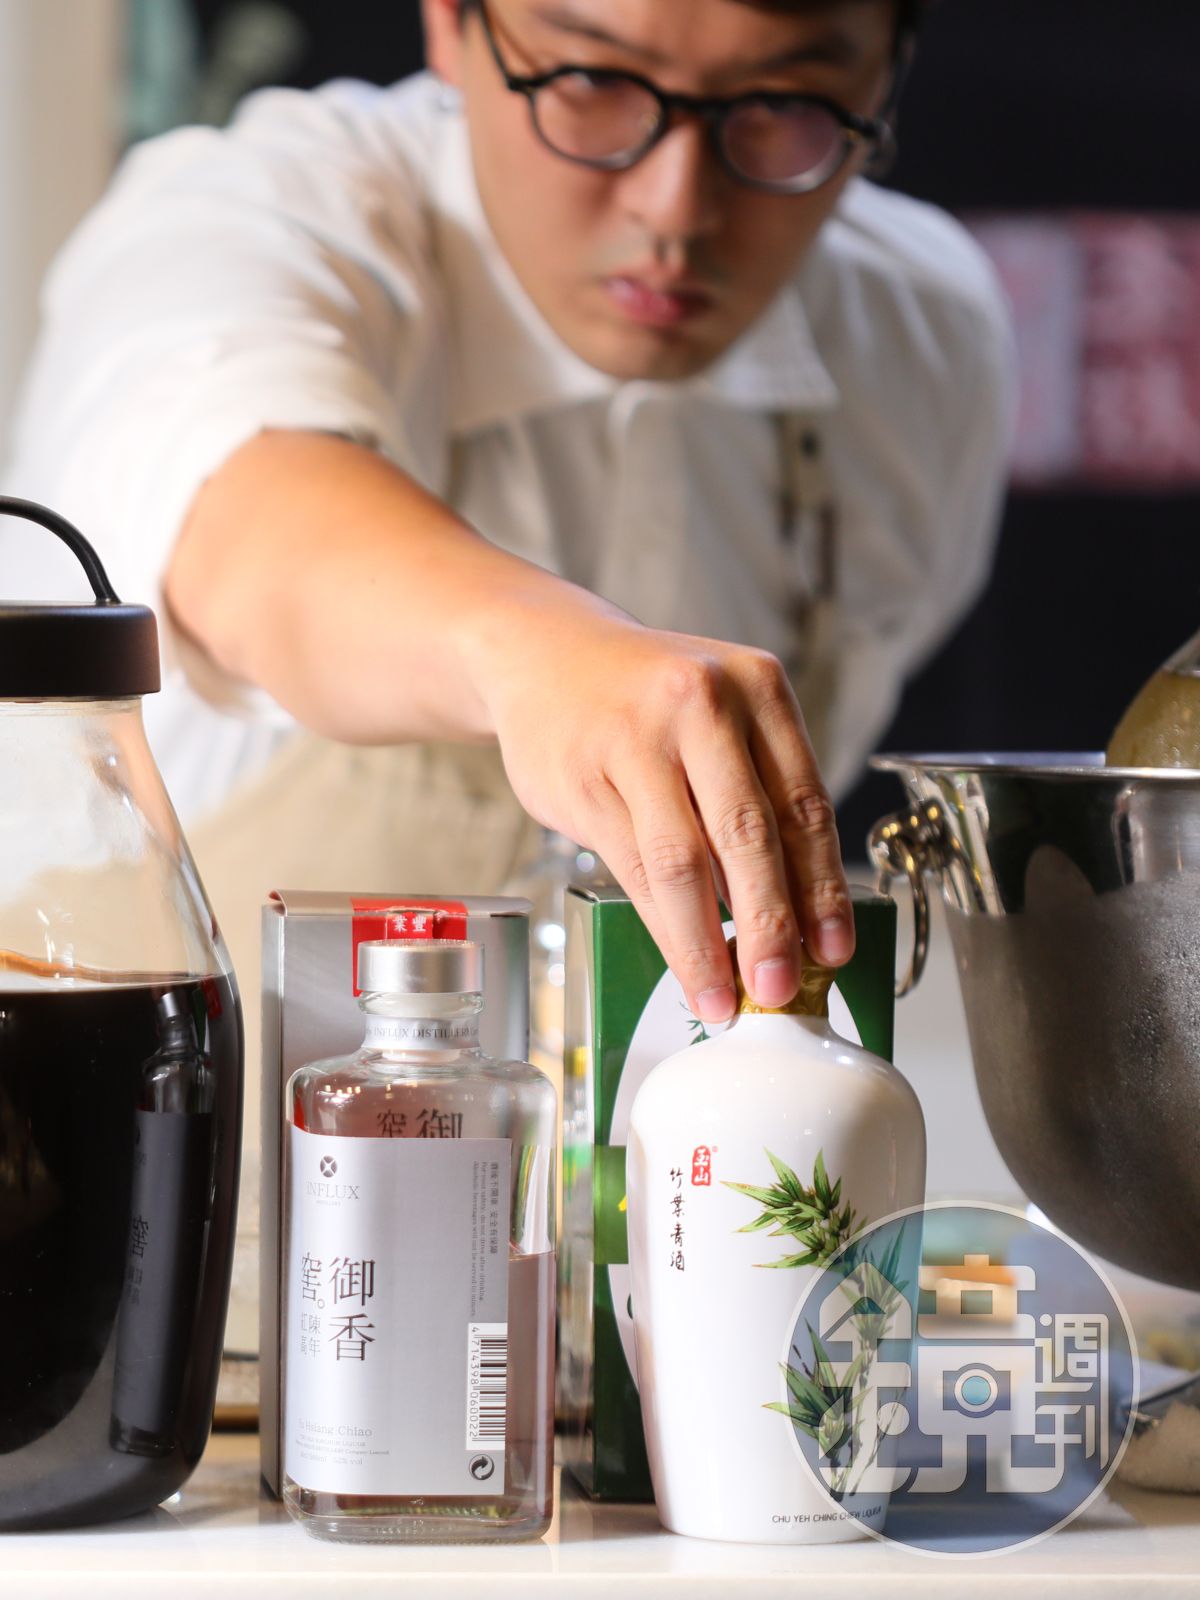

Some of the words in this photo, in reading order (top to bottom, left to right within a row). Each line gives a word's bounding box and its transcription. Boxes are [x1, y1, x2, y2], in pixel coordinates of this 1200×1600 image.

[693, 1147, 710, 1184] 玉山
[328, 1257, 375, 1361] 御香
[772, 1515, 791, 1523] CHU
[793, 1514, 810, 1523] YEH
[813, 1512, 838, 1522] CHING
